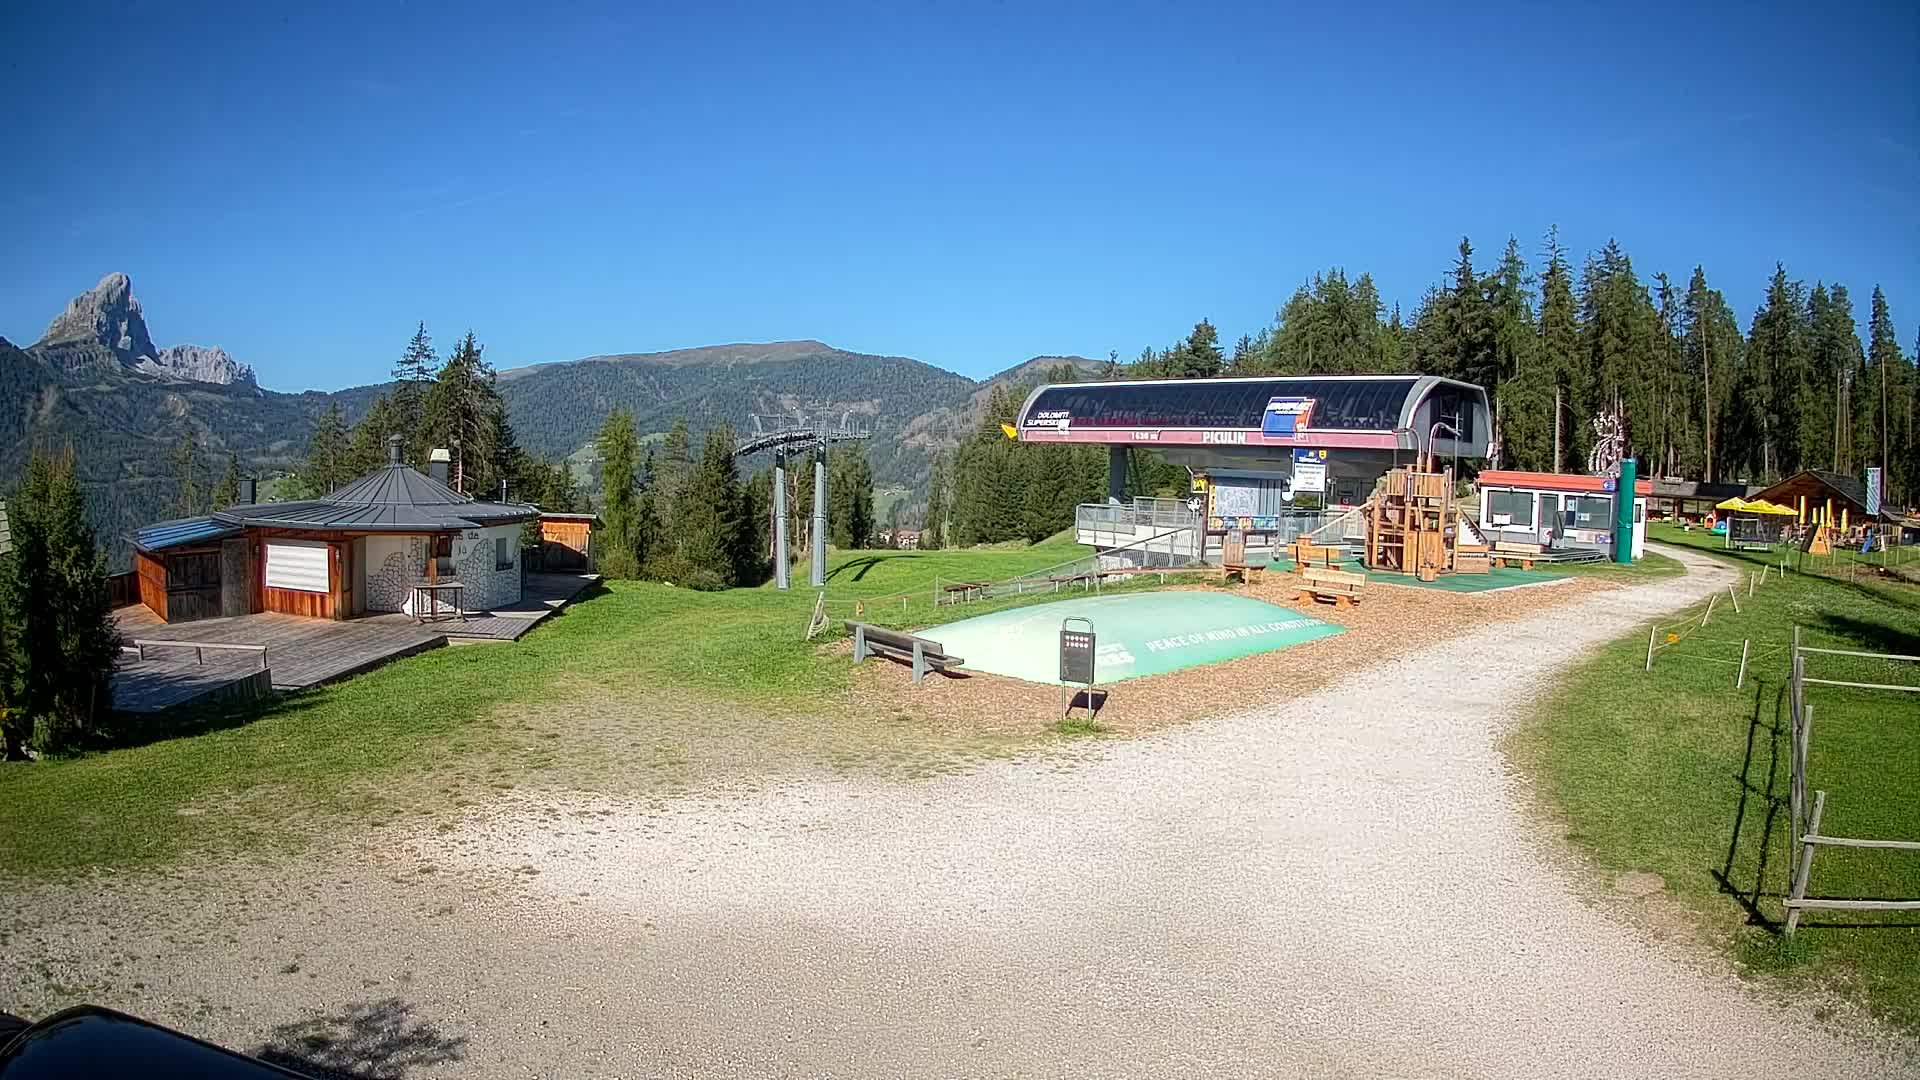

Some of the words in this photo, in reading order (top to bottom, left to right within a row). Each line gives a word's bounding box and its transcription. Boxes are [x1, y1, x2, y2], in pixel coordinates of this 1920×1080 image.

[1037, 411, 1070, 419] DOLOMITI
[1202, 431, 1246, 444] PICULIN
[1144, 634, 1190, 652] PEACE
[1188, 632, 1205, 645] OF
[1205, 628, 1236, 641] MIND
[1236, 626, 1251, 638] IN
[1249, 624, 1270, 635] ALL
